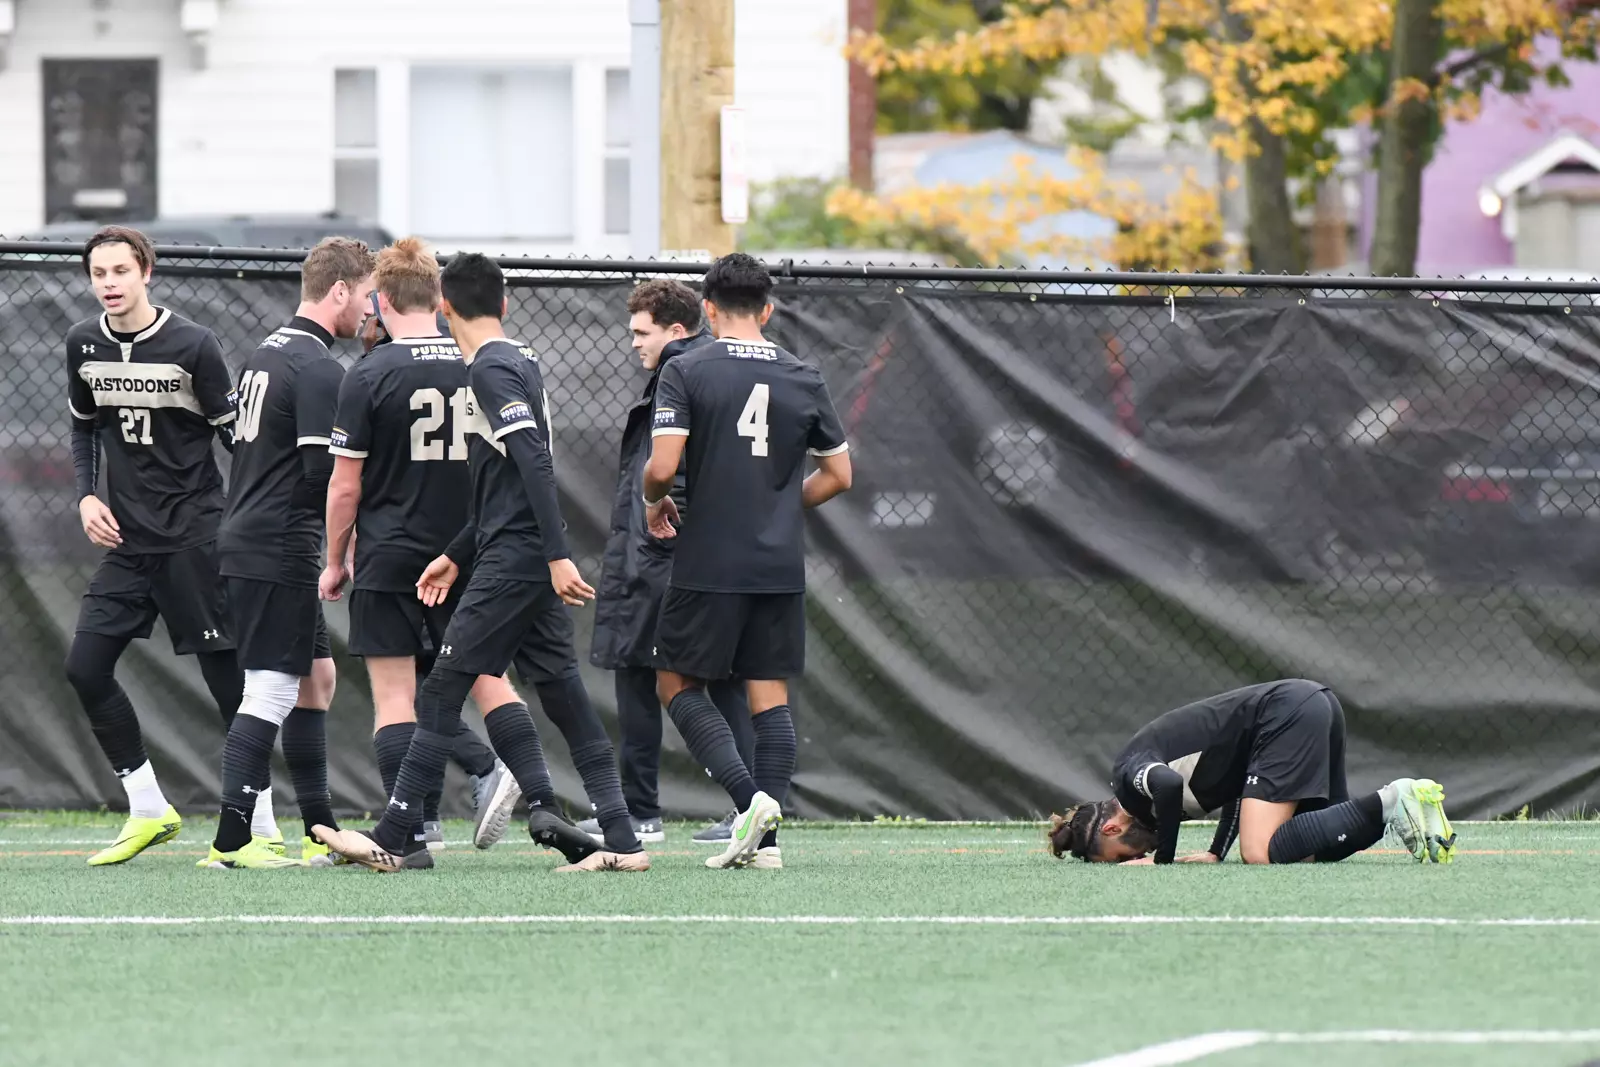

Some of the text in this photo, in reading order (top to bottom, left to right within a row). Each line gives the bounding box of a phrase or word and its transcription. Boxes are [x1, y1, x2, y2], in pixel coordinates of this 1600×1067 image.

[118, 408, 154, 445] 27
[235, 370, 269, 443] 30
[409, 387, 469, 461] 21
[737, 383, 769, 457] 4
